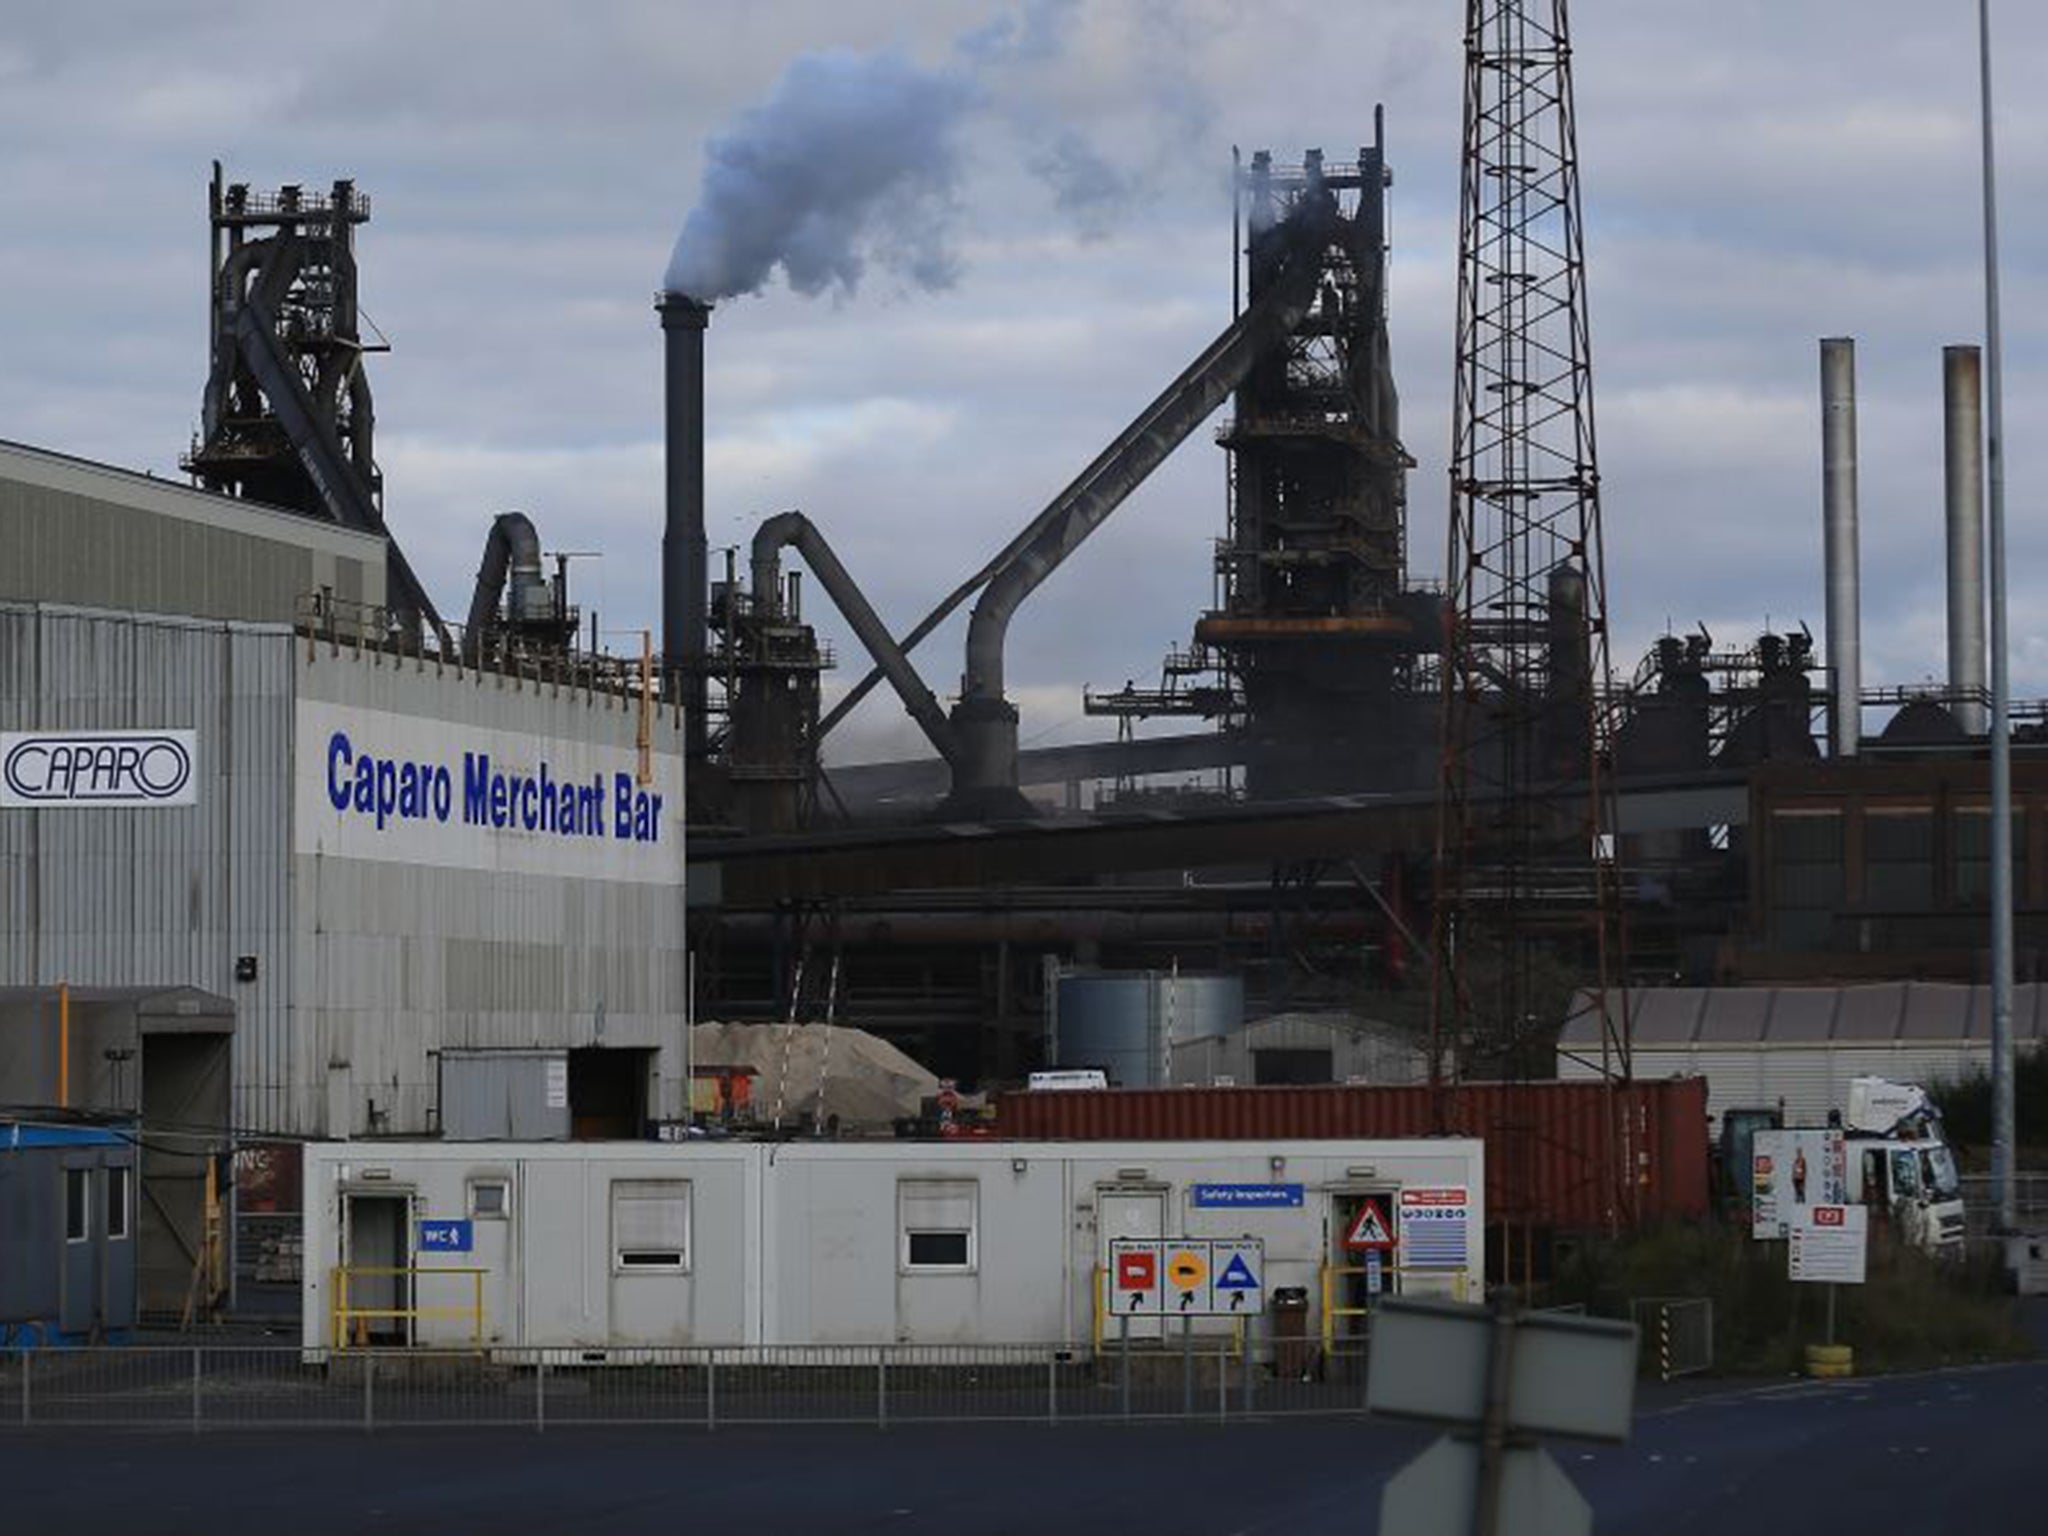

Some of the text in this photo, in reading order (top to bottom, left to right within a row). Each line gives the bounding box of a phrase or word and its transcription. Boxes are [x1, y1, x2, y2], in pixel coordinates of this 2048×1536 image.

[11, 743, 184, 799] CAPARO
[328, 732, 662, 842] Caparo Merchant Bar
[424, 1230, 448, 1242] WC
